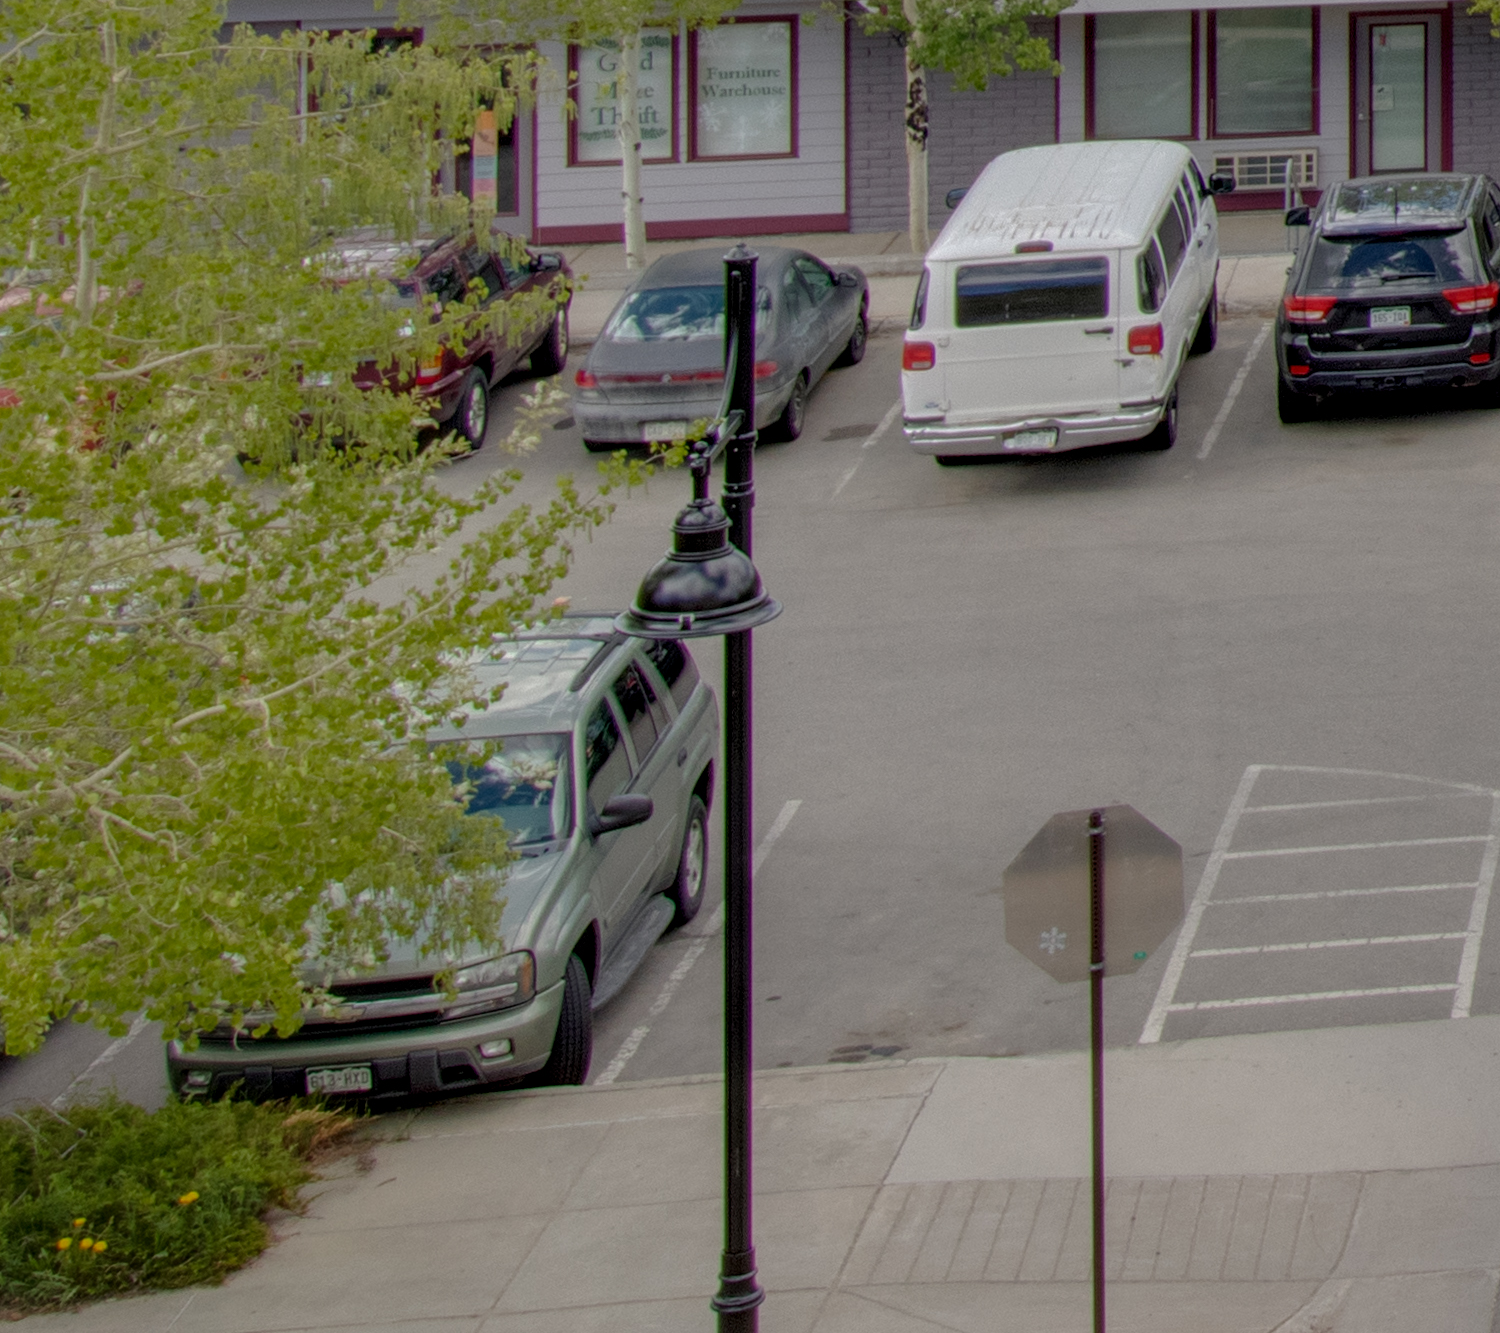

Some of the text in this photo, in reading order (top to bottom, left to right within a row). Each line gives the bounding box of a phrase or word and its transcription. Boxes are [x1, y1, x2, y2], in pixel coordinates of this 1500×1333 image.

[598, 51, 653, 72] Gd
[706, 67, 781, 80] Furniture
[700, 83, 787, 98] Warehouse
[590, 105, 659, 125] Thift
